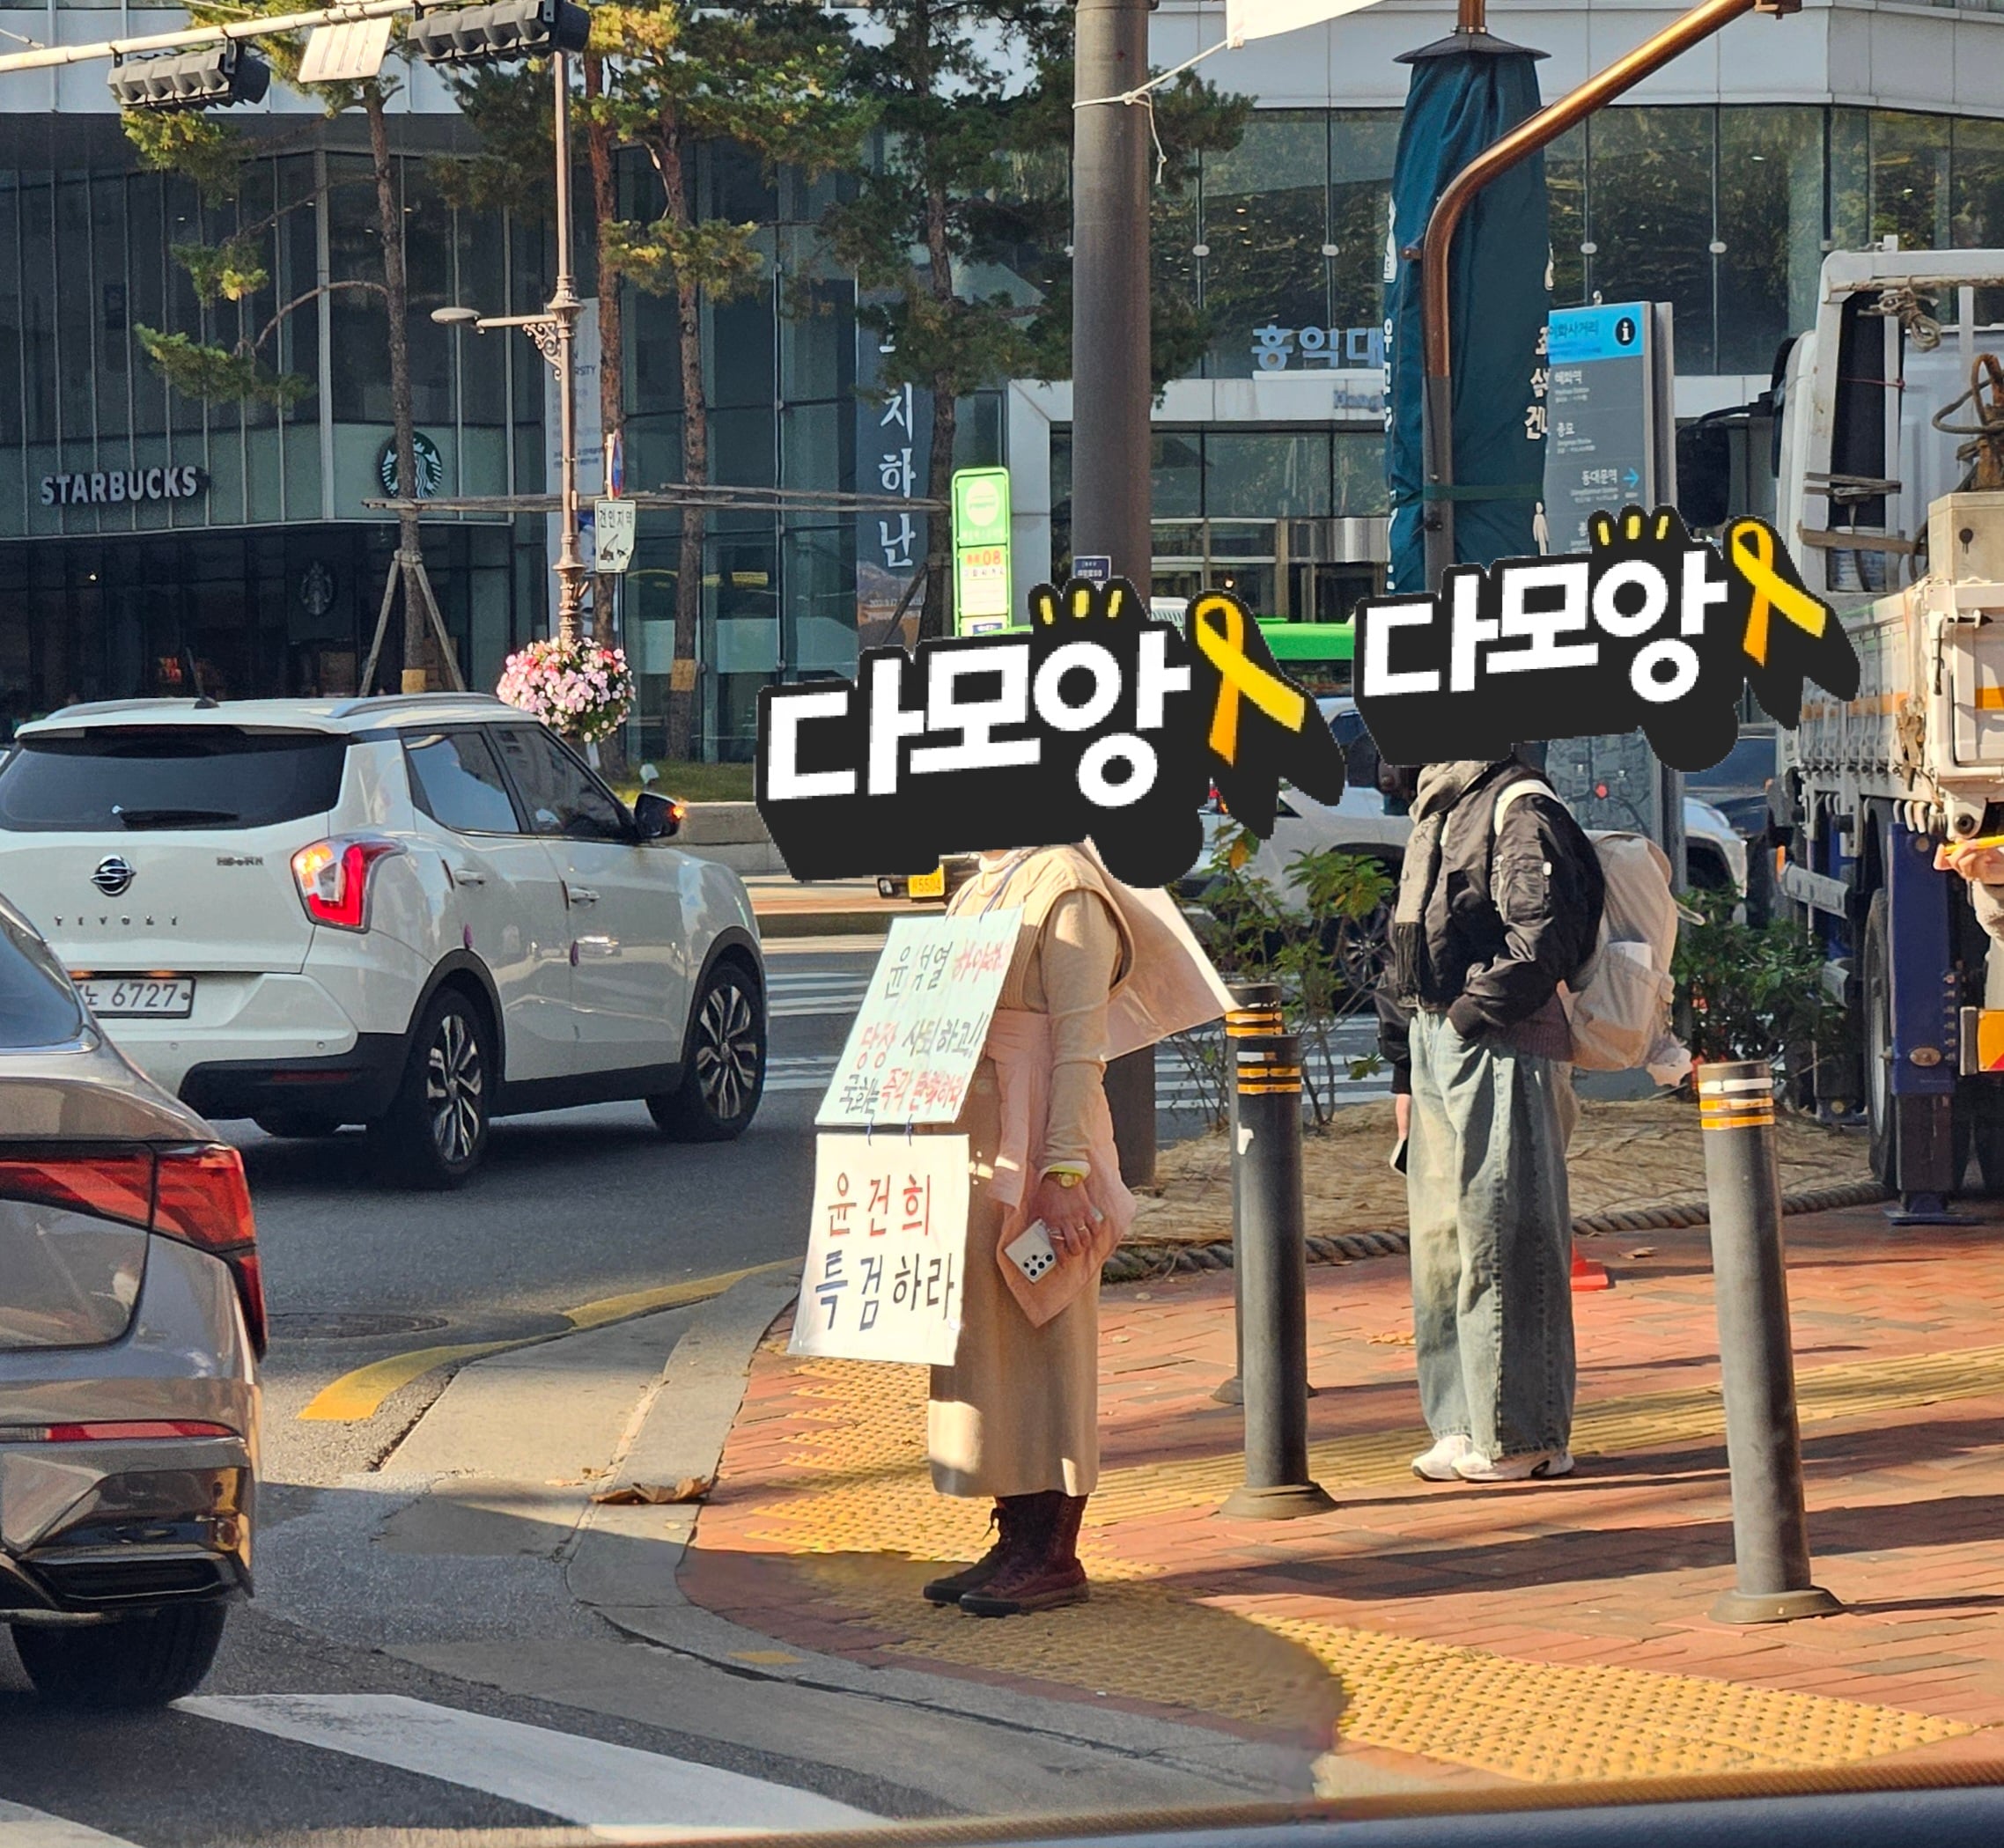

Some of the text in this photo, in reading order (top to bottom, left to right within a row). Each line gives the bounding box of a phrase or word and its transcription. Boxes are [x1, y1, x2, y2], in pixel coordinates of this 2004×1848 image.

[41, 466, 198, 506] STARBUCKS
[598, 508, 633, 529] 견인지역
[54, 914, 179, 927] TIVOLI
[883, 940, 954, 1000] 윤석열
[111, 982, 179, 1008] 6727
[856, 1020, 898, 1071] 당장
[827, 1172, 931, 1238] 윤건희
[814, 1248, 955, 1332] 특검하라
